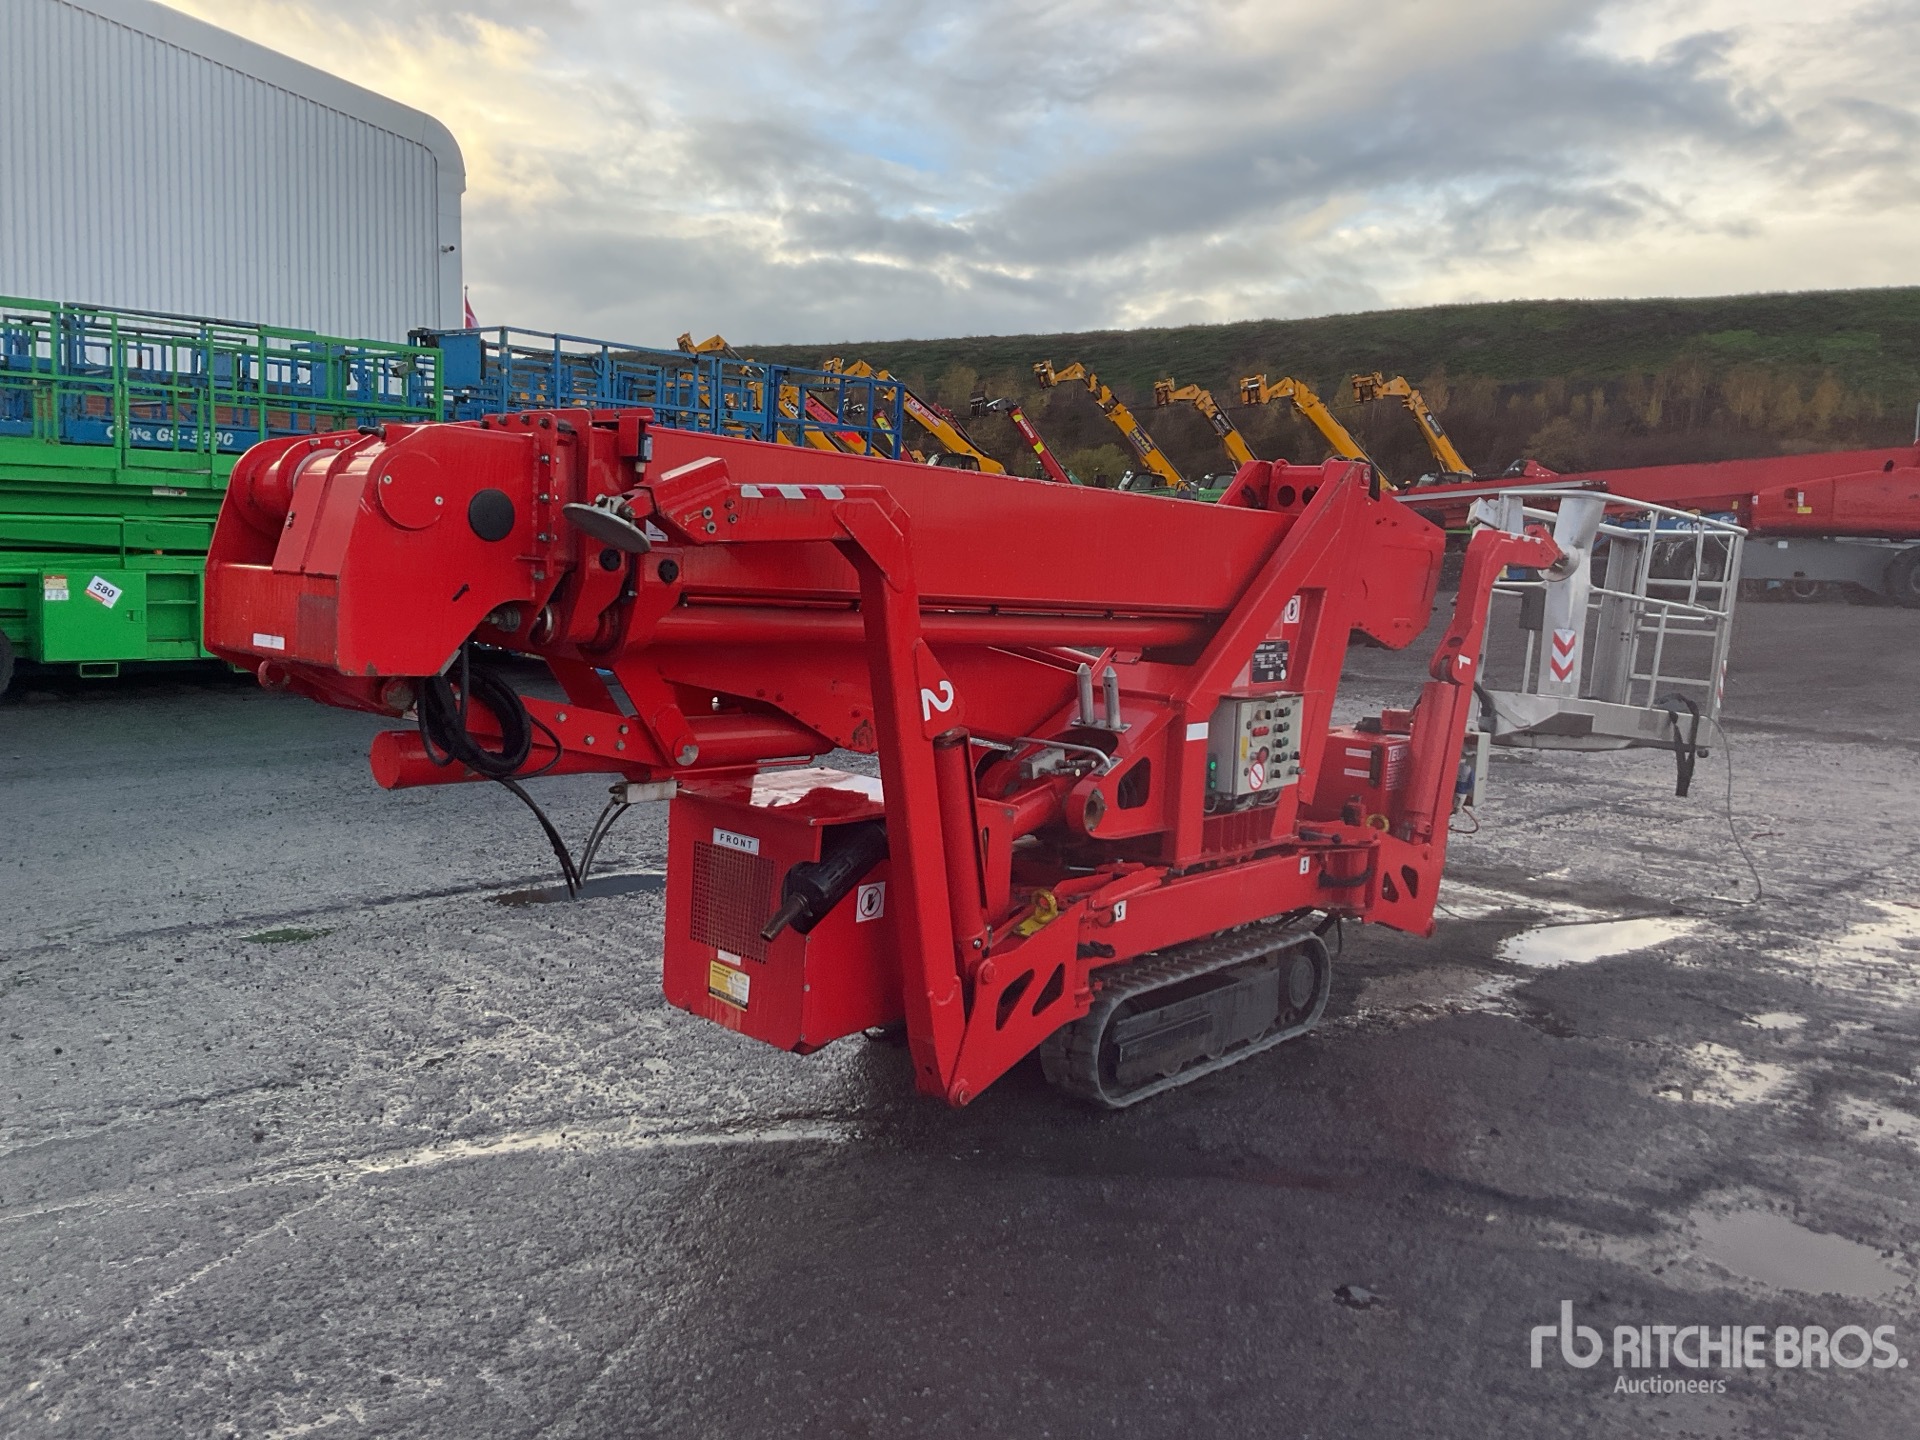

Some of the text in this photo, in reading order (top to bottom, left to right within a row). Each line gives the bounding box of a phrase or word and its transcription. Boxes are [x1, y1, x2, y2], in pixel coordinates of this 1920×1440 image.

[94, 582, 115, 598] 580
[920, 680, 955, 722] 2
[720, 833, 753, 849] FRONT
